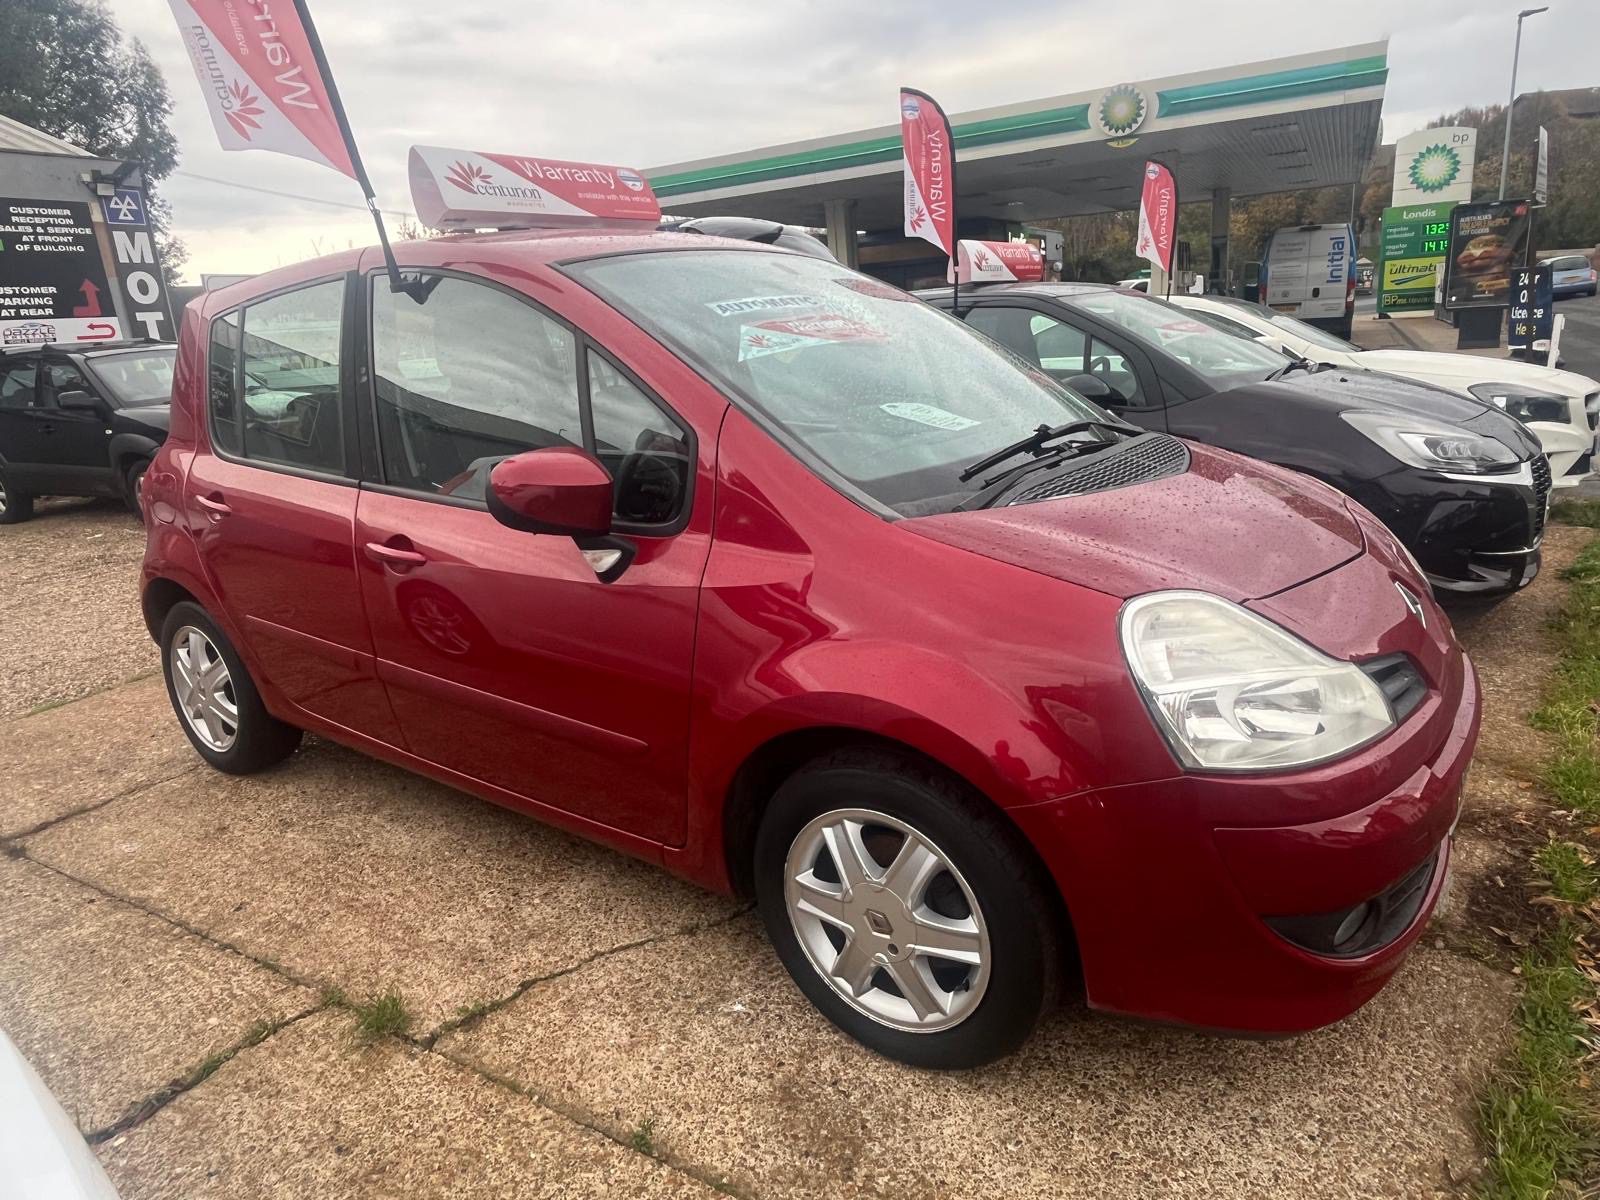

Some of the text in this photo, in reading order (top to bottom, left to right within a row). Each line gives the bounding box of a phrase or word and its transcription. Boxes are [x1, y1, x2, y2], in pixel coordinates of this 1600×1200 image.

[1452, 132, 1469, 145] bp
[514, 159, 615, 190] Warranty
[9, 206, 72, 216] CUSTOMER
[1403, 208, 1437, 220] Londis
[11, 216, 74, 225] RECEPTION
[0, 224, 33, 233] SALES
[47, 226, 93, 235] SERVICE
[38, 235, 74, 243] FRONT
[15, 244, 85, 252] OF BUILDING
[1326, 236, 1346, 284] Initial
[1390, 262, 1437, 275] ultimat
[112, 230, 164, 341] MOT
[716, 296, 818, 314] AUTOMATIC
[1, 308, 54, 317] AT REAR
[1511, 306, 1544, 318] Licee
